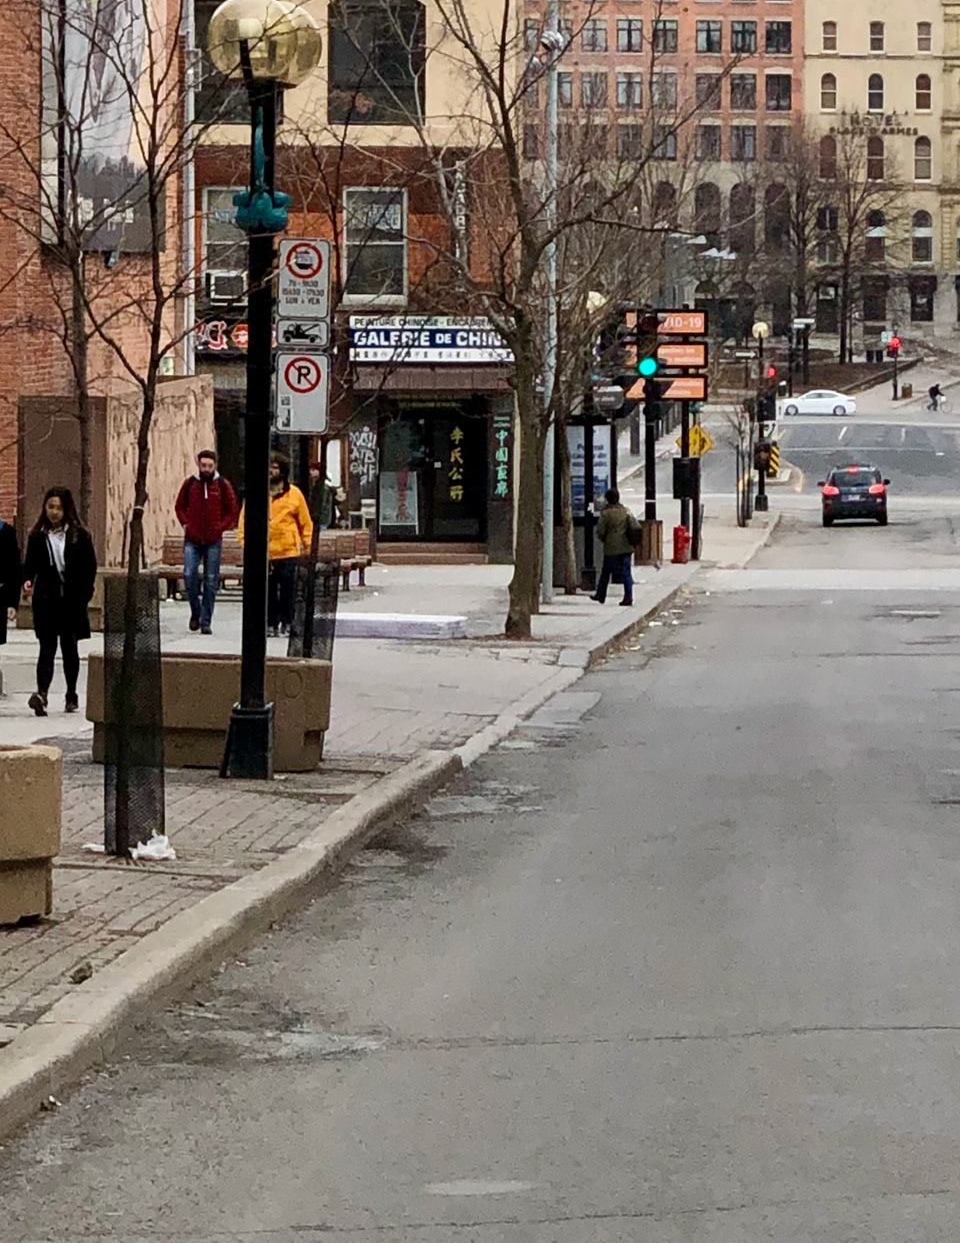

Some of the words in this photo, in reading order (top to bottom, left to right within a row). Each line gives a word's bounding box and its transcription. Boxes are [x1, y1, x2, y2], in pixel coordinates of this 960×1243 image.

[354, 318, 396, 327] PEINTURE
[399, 318, 438, 326] CHINOISE
[354, 331, 430, 346] GALERIE
[435, 333, 452, 345] DE
[456, 331, 508, 346] CHIN
